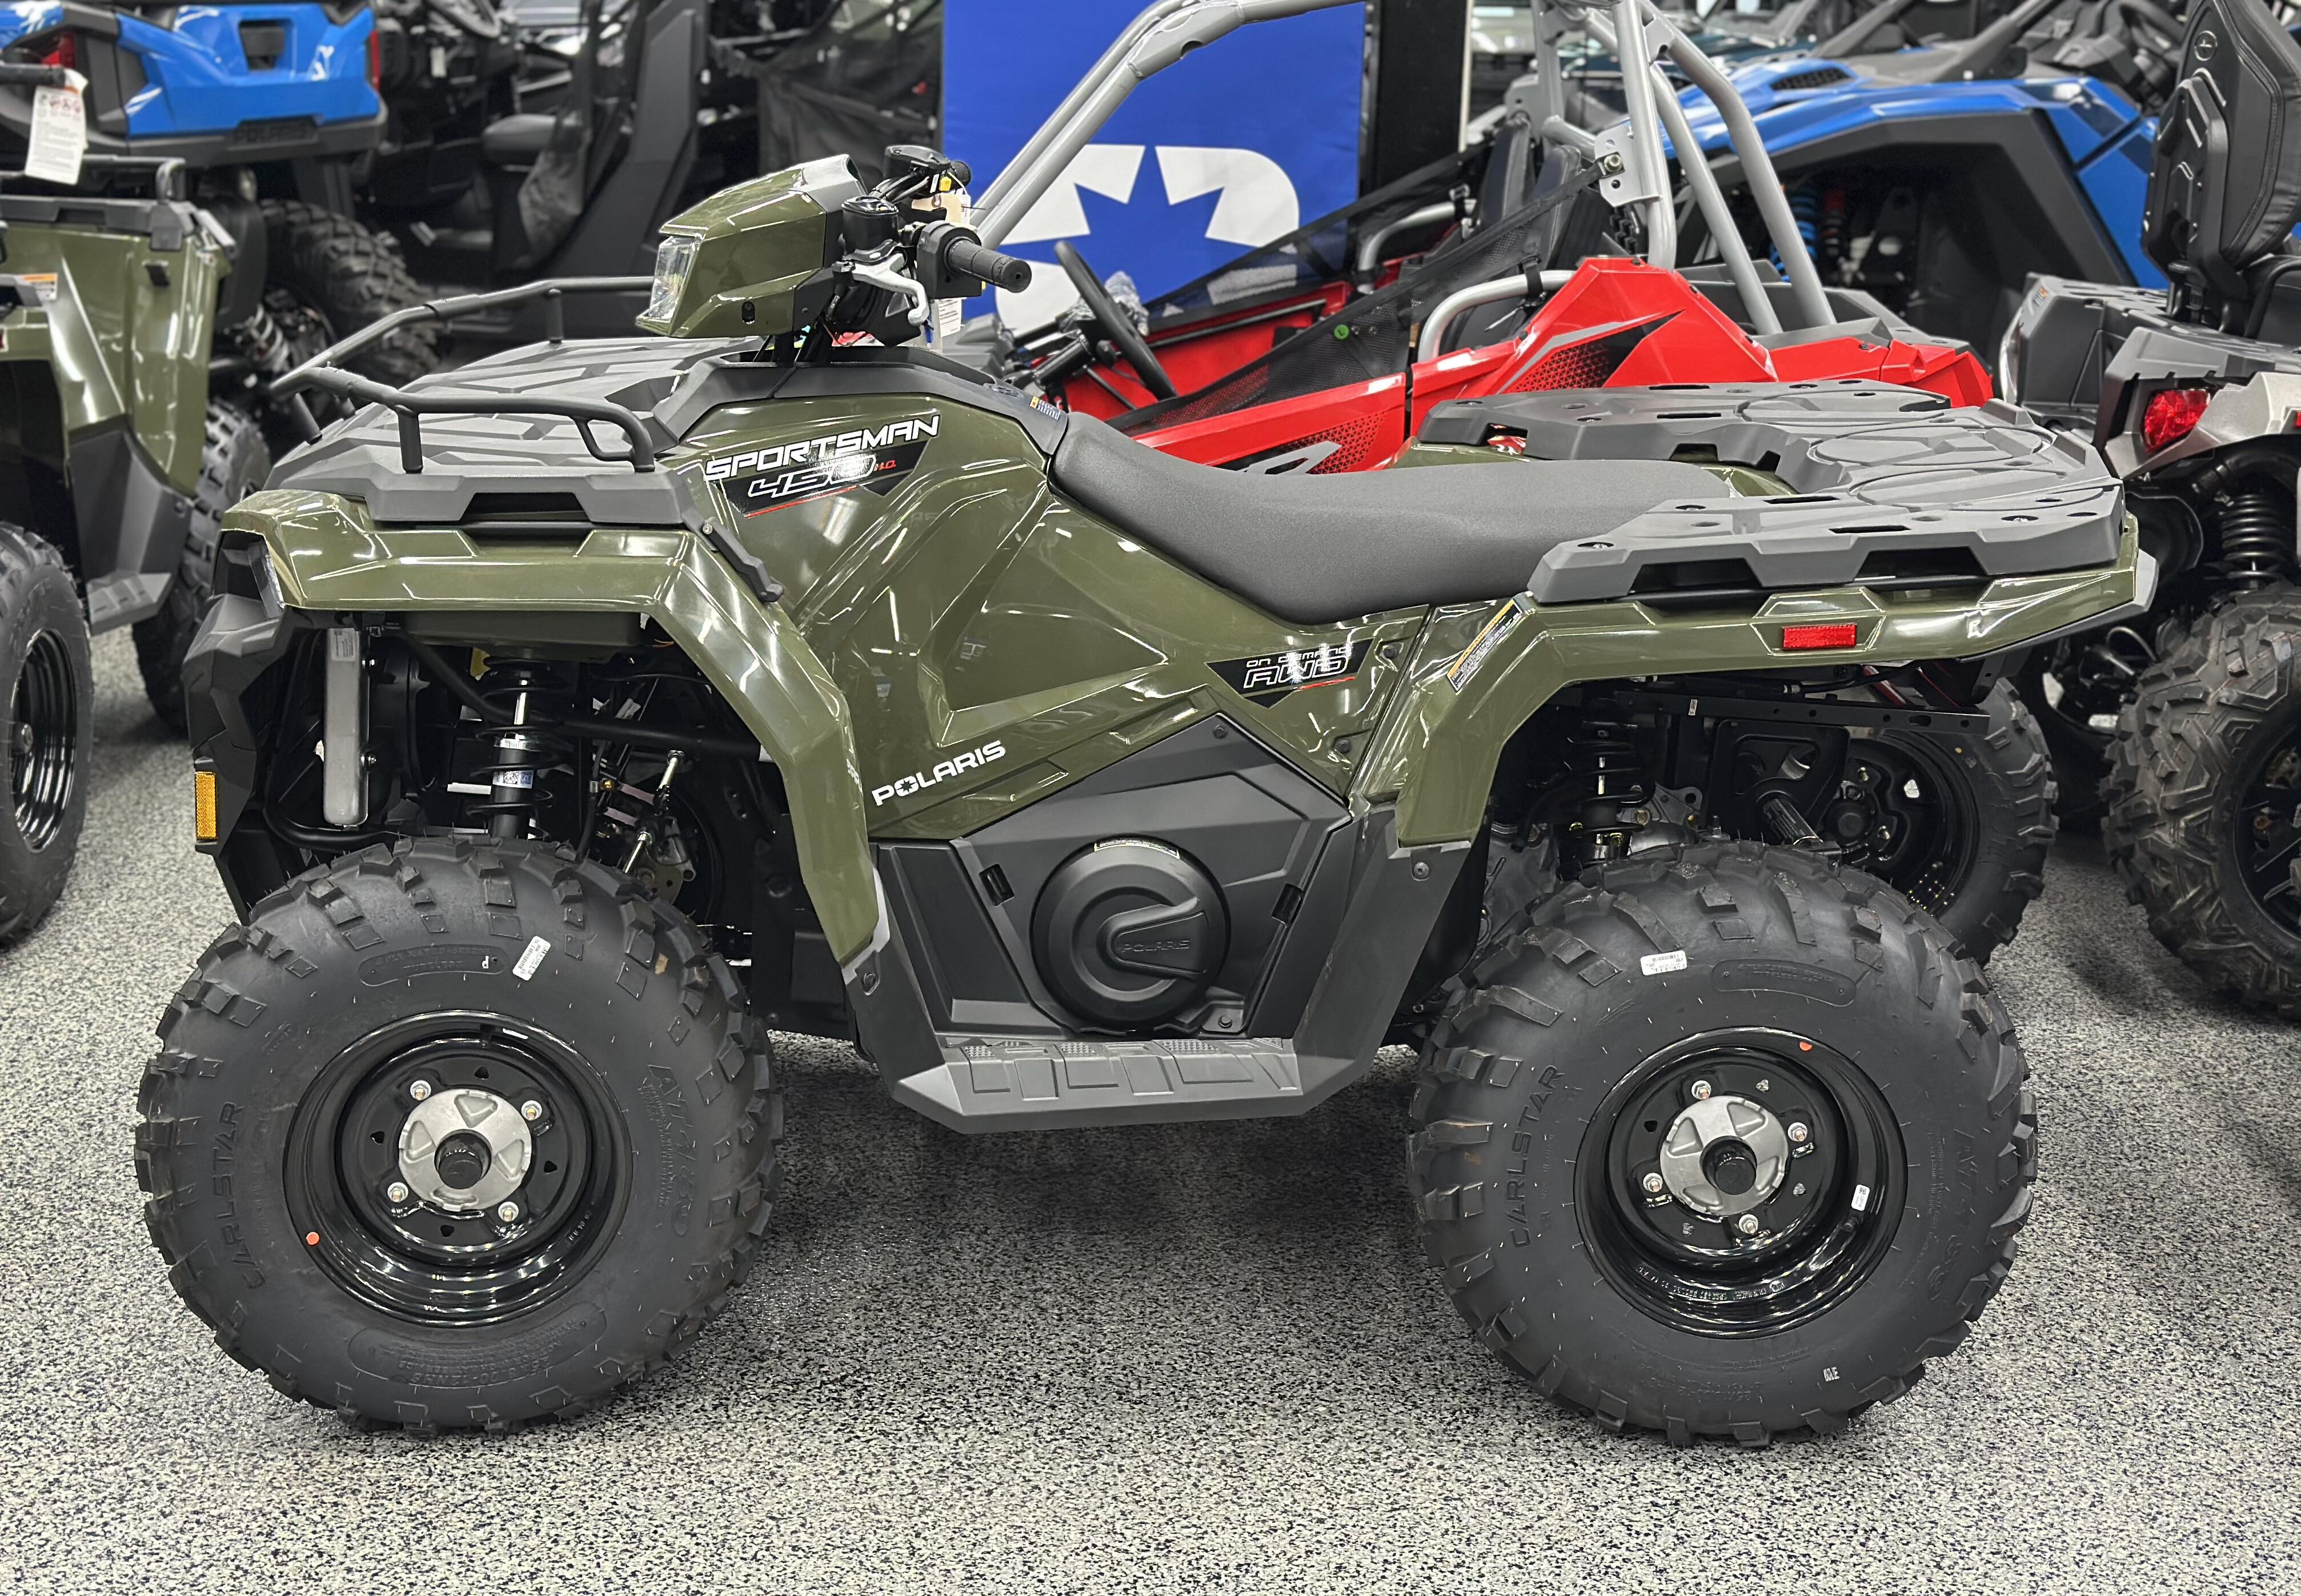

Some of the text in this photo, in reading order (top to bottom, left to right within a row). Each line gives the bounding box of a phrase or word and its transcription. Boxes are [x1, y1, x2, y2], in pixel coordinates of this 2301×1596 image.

[705, 415, 941, 480] SPORTSMAN
[748, 455, 876, 498] 450
[1244, 657, 1348, 688] AWD
[872, 740, 1005, 806] POLARIS
[1121, 940, 1190, 953] POLARIS
[1505, 1065, 1566, 1248] CARLSTAR
[212, 1101, 267, 1290] CARLSTAR
